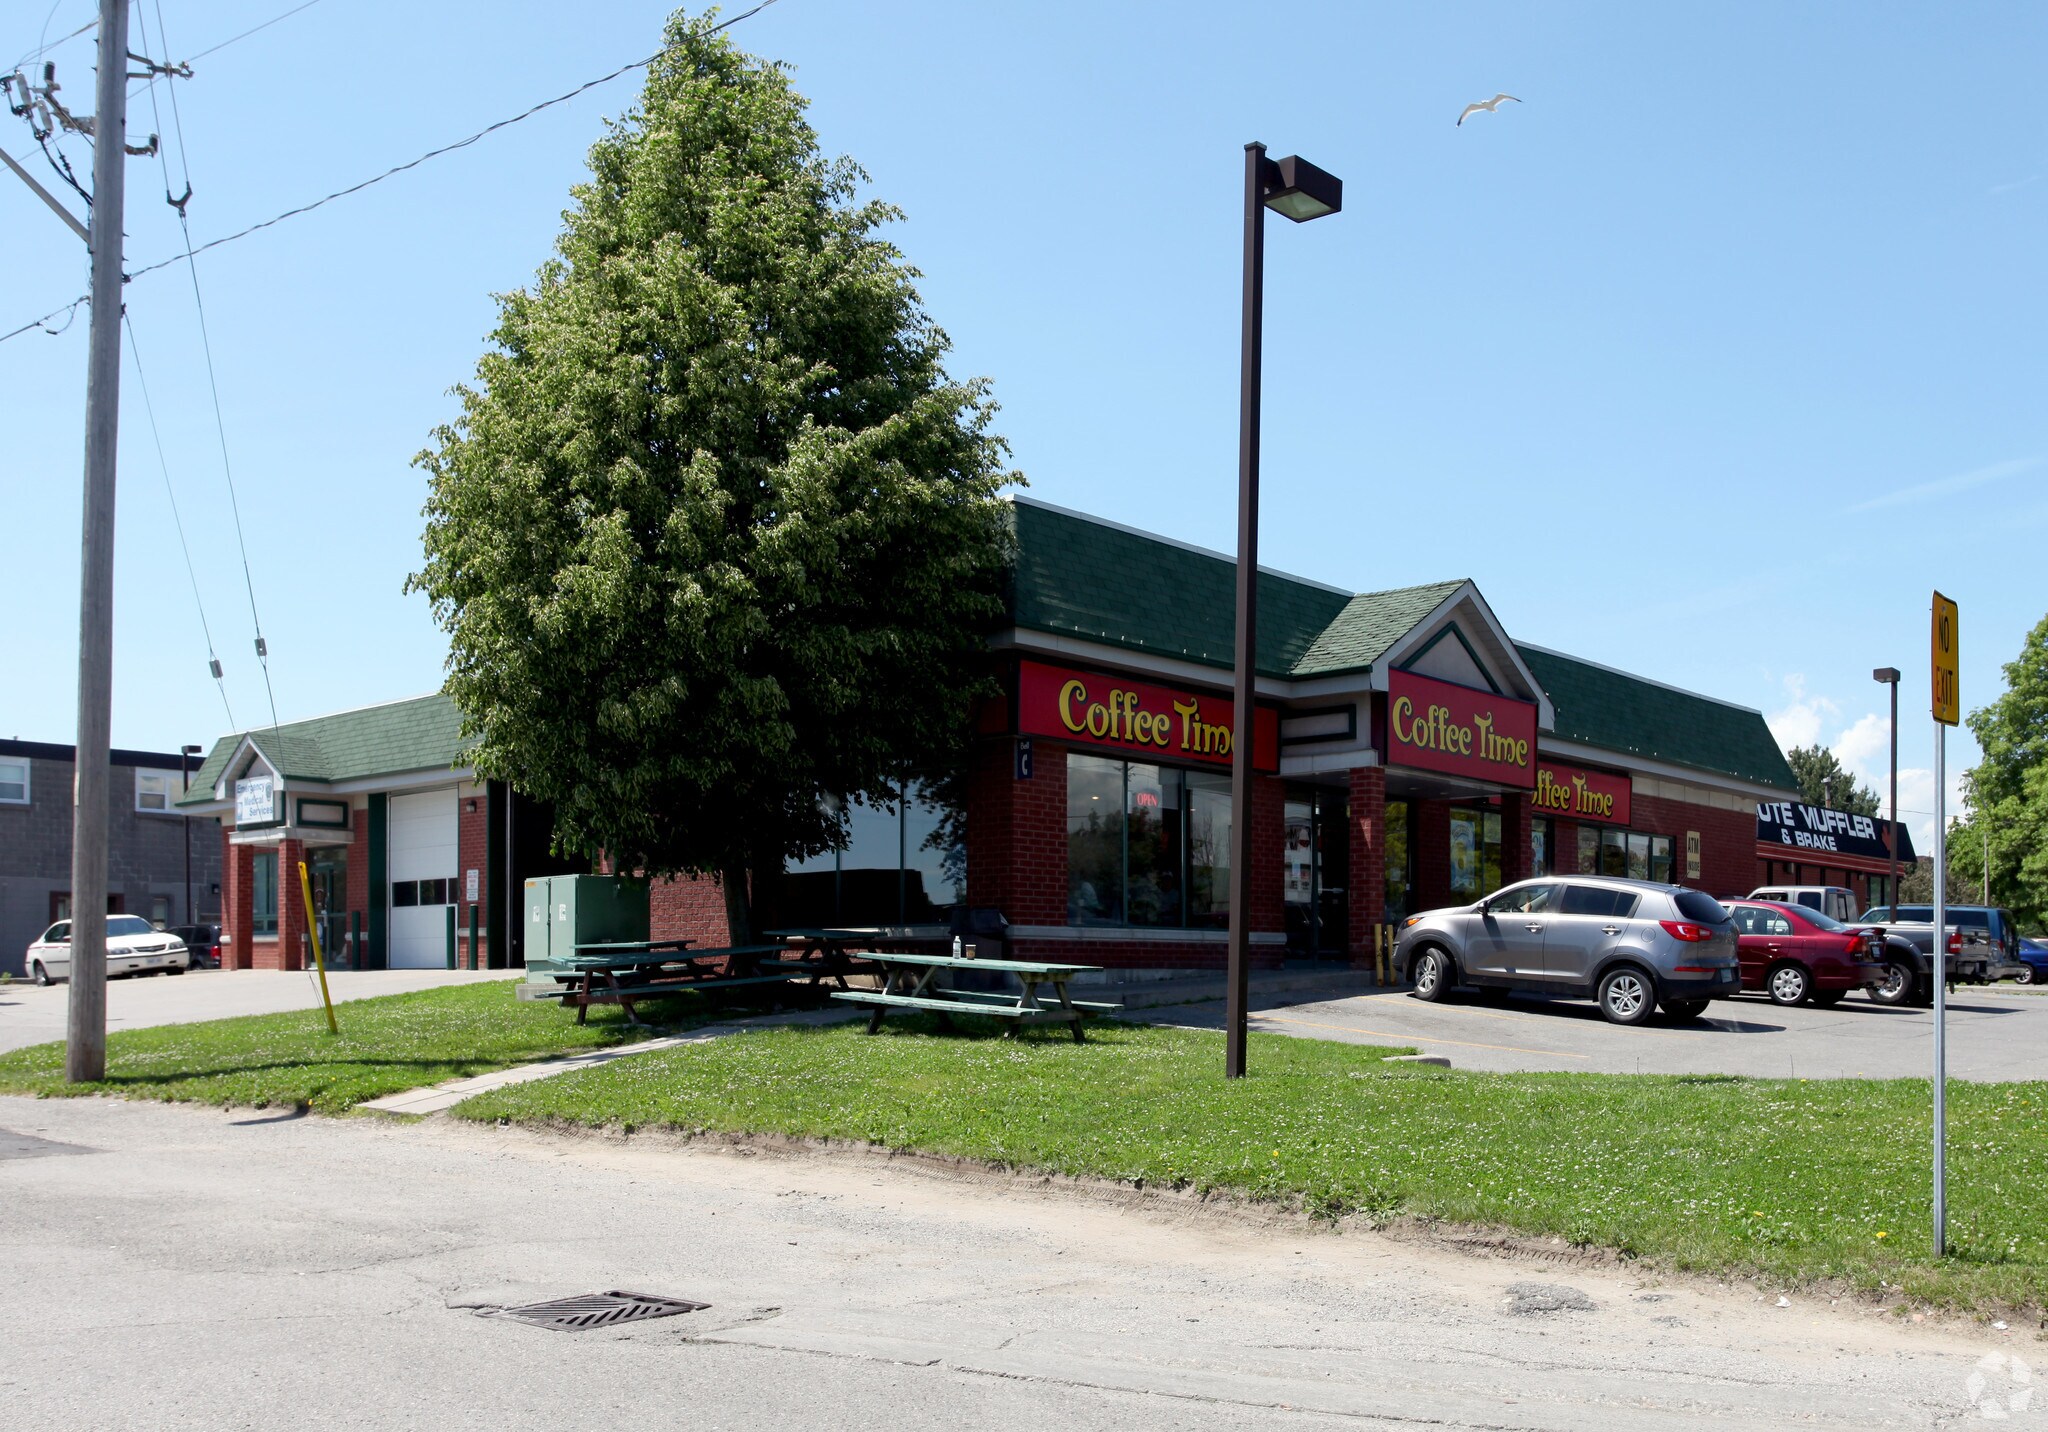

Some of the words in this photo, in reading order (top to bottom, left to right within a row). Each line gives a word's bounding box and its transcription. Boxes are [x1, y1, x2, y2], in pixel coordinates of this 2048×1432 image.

[1938, 613, 1950, 653] NO
[1936, 665, 1953, 707] EXIT
[1058, 679, 1170, 746] Coffee
[1173, 697, 1235, 756] Tim
[1392, 695, 1472, 756] Coffee
[1473, 711, 1528, 767] Time
[249, 806, 273, 817] Services
[1137, 792, 1158, 807] OPEN
[1531, 769, 1571, 811] ffee
[1571, 772, 1613, 817] Time
[1780, 828, 1792, 845] &
[1795, 830, 1838, 852] BRAKE
[1798, 804, 1877, 841] MUFFLER
[1687, 836, 1700, 854] ATM
[1687, 860, 1700, 872] INSIDE
